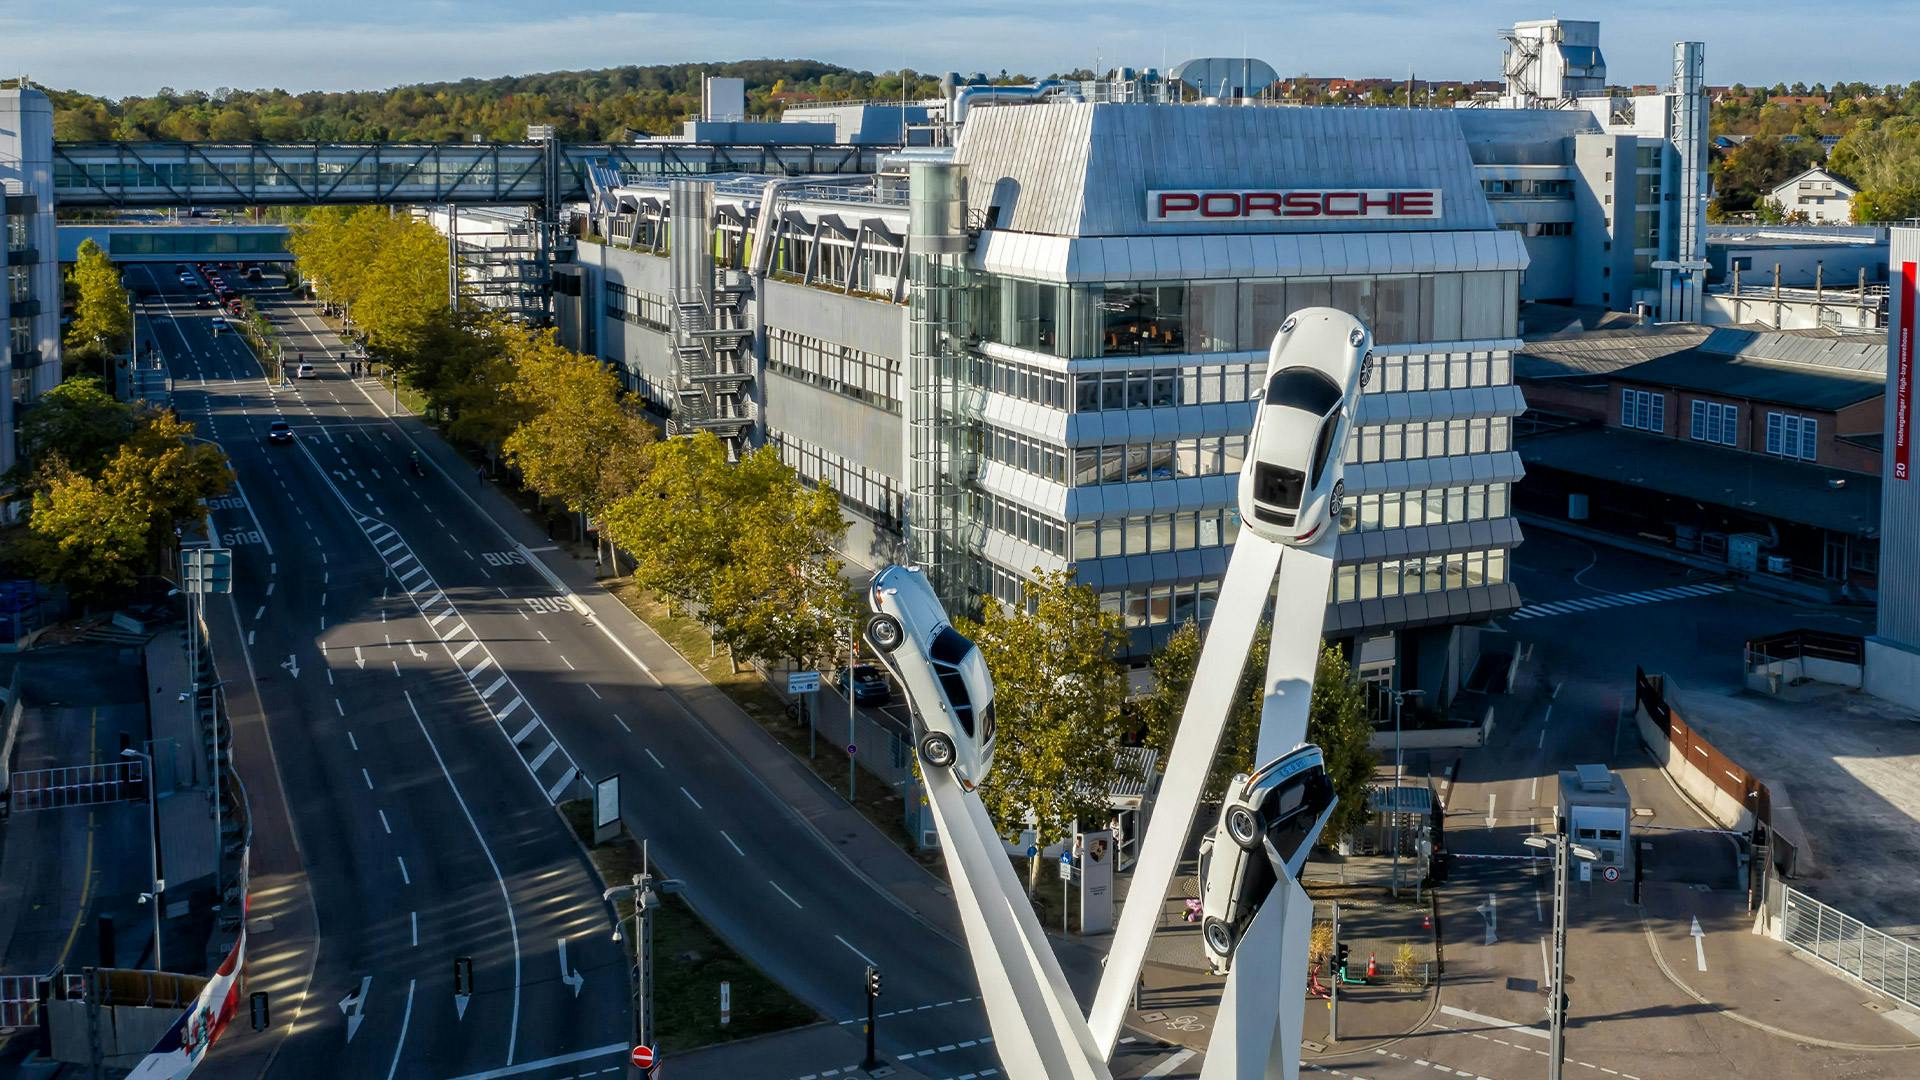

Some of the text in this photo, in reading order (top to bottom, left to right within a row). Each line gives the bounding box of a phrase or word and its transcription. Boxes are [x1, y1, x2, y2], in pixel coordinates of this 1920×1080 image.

[1159, 192, 1434, 218] PORSCHE
[1899, 363, 1908, 392] High-bay
[1898, 398, 1907, 447] Hochregallager
[1896, 462, 1906, 477] 20
[208, 497, 245, 510] BUS
[222, 531, 262, 546] BUS
[482, 551, 527, 567] BUS
[523, 596, 575, 614] BUS
